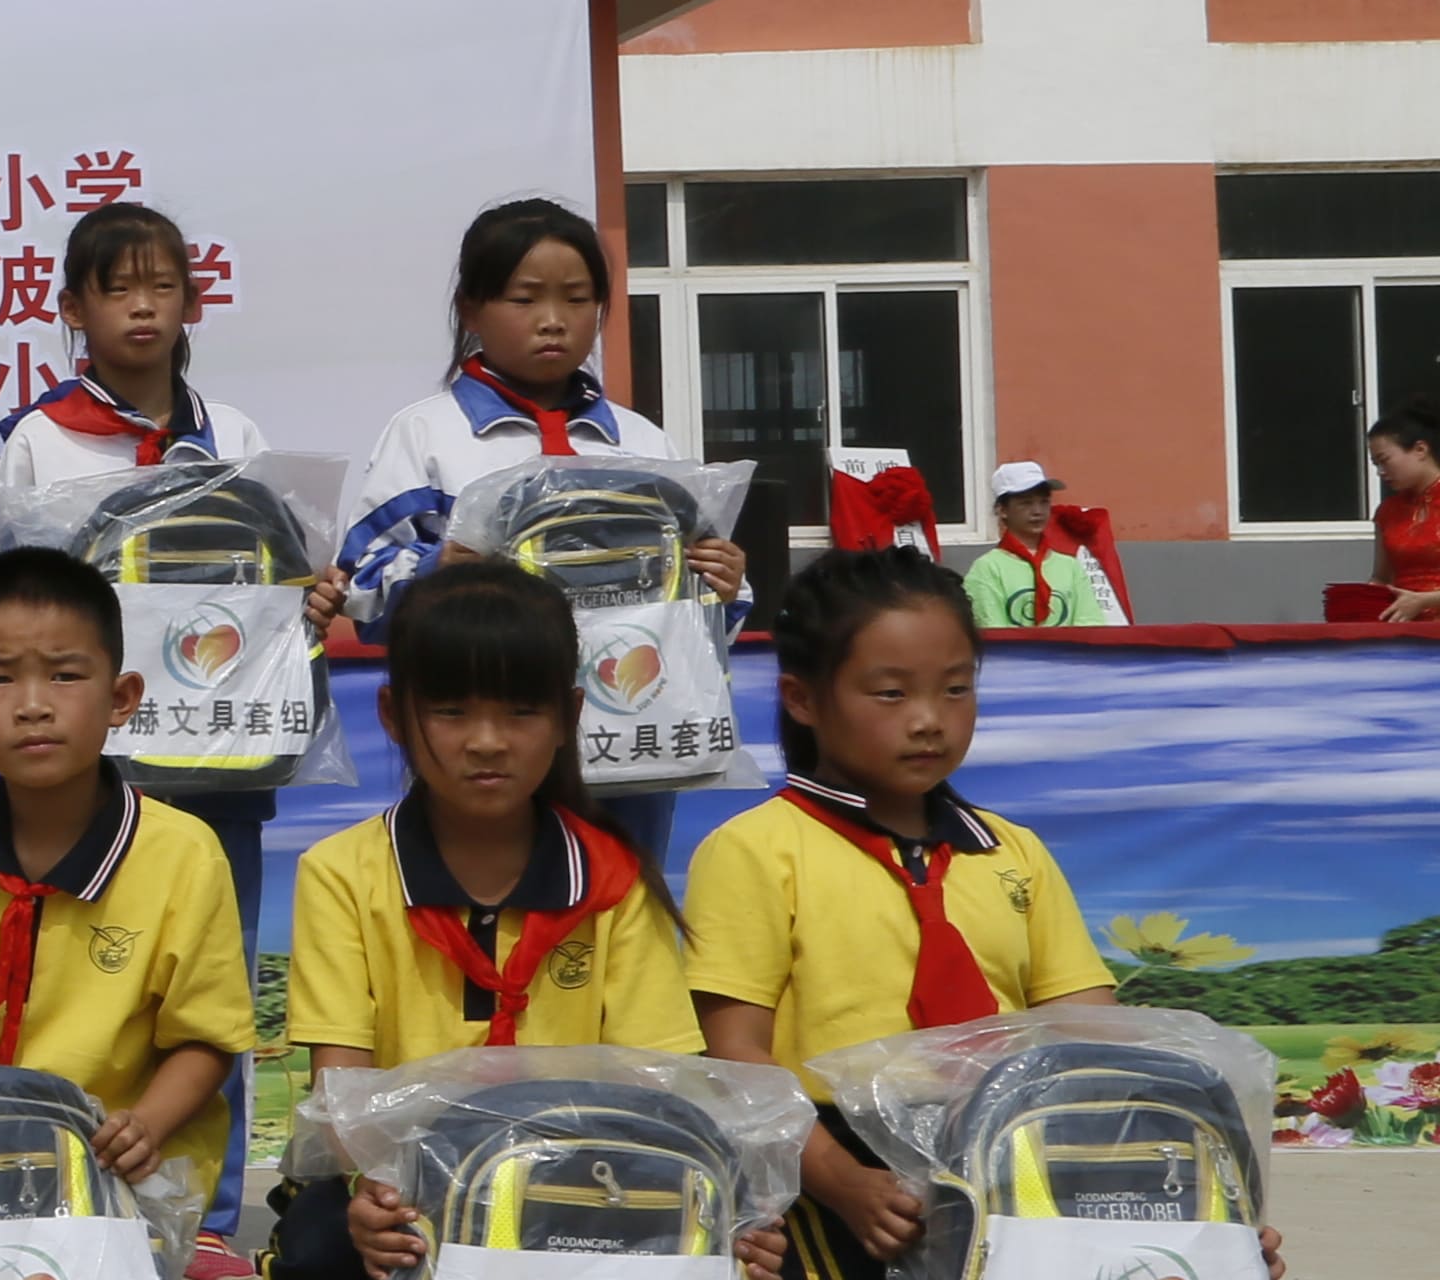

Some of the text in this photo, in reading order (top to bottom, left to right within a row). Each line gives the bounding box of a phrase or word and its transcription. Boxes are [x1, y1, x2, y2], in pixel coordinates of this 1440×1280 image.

[570, 591, 647, 608] EGEBAOBEI
[111, 698, 310, 736] 赫文具套组
[587, 717, 735, 764] 文具套组
